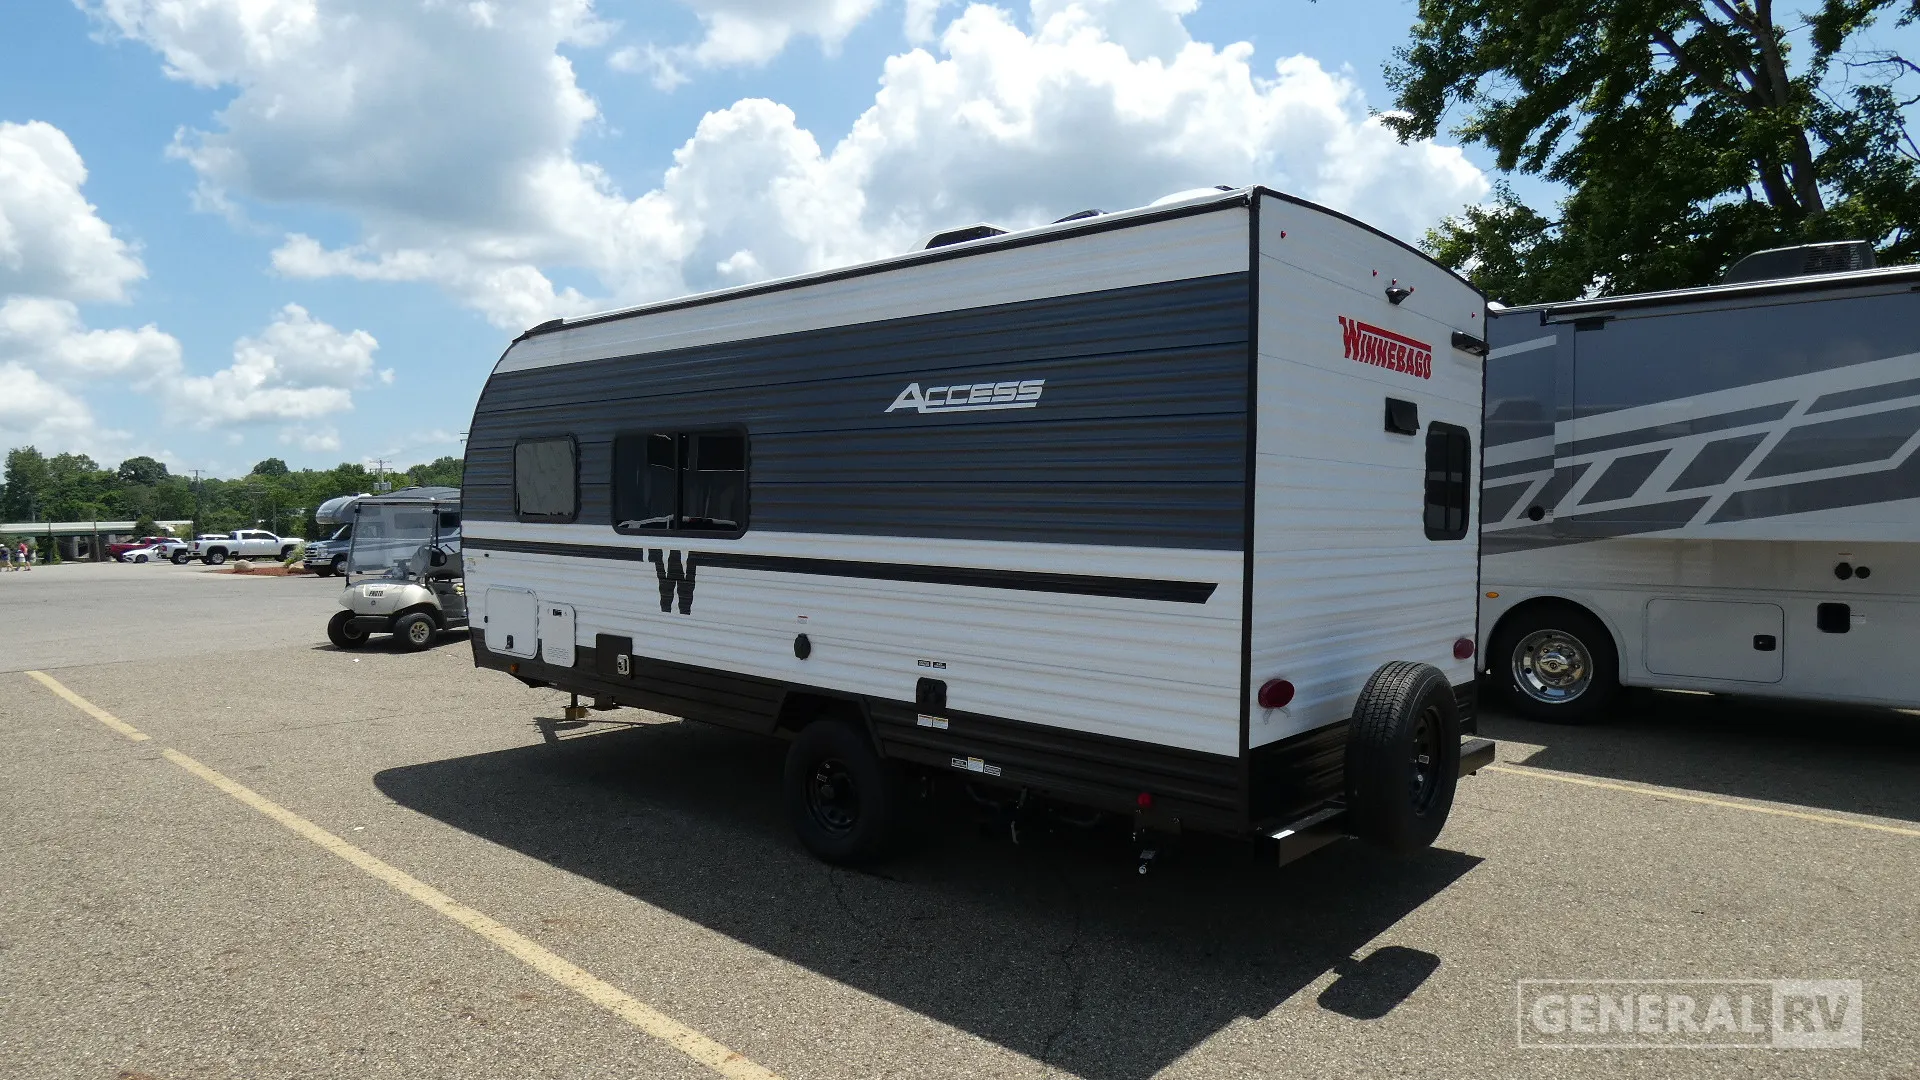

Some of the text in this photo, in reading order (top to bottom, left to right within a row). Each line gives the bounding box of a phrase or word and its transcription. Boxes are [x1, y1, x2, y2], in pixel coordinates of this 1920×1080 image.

[1338, 315, 1432, 380] WINNEBAGO
[884, 379, 1046, 414] ACCESS
[647, 548, 697, 616] W
